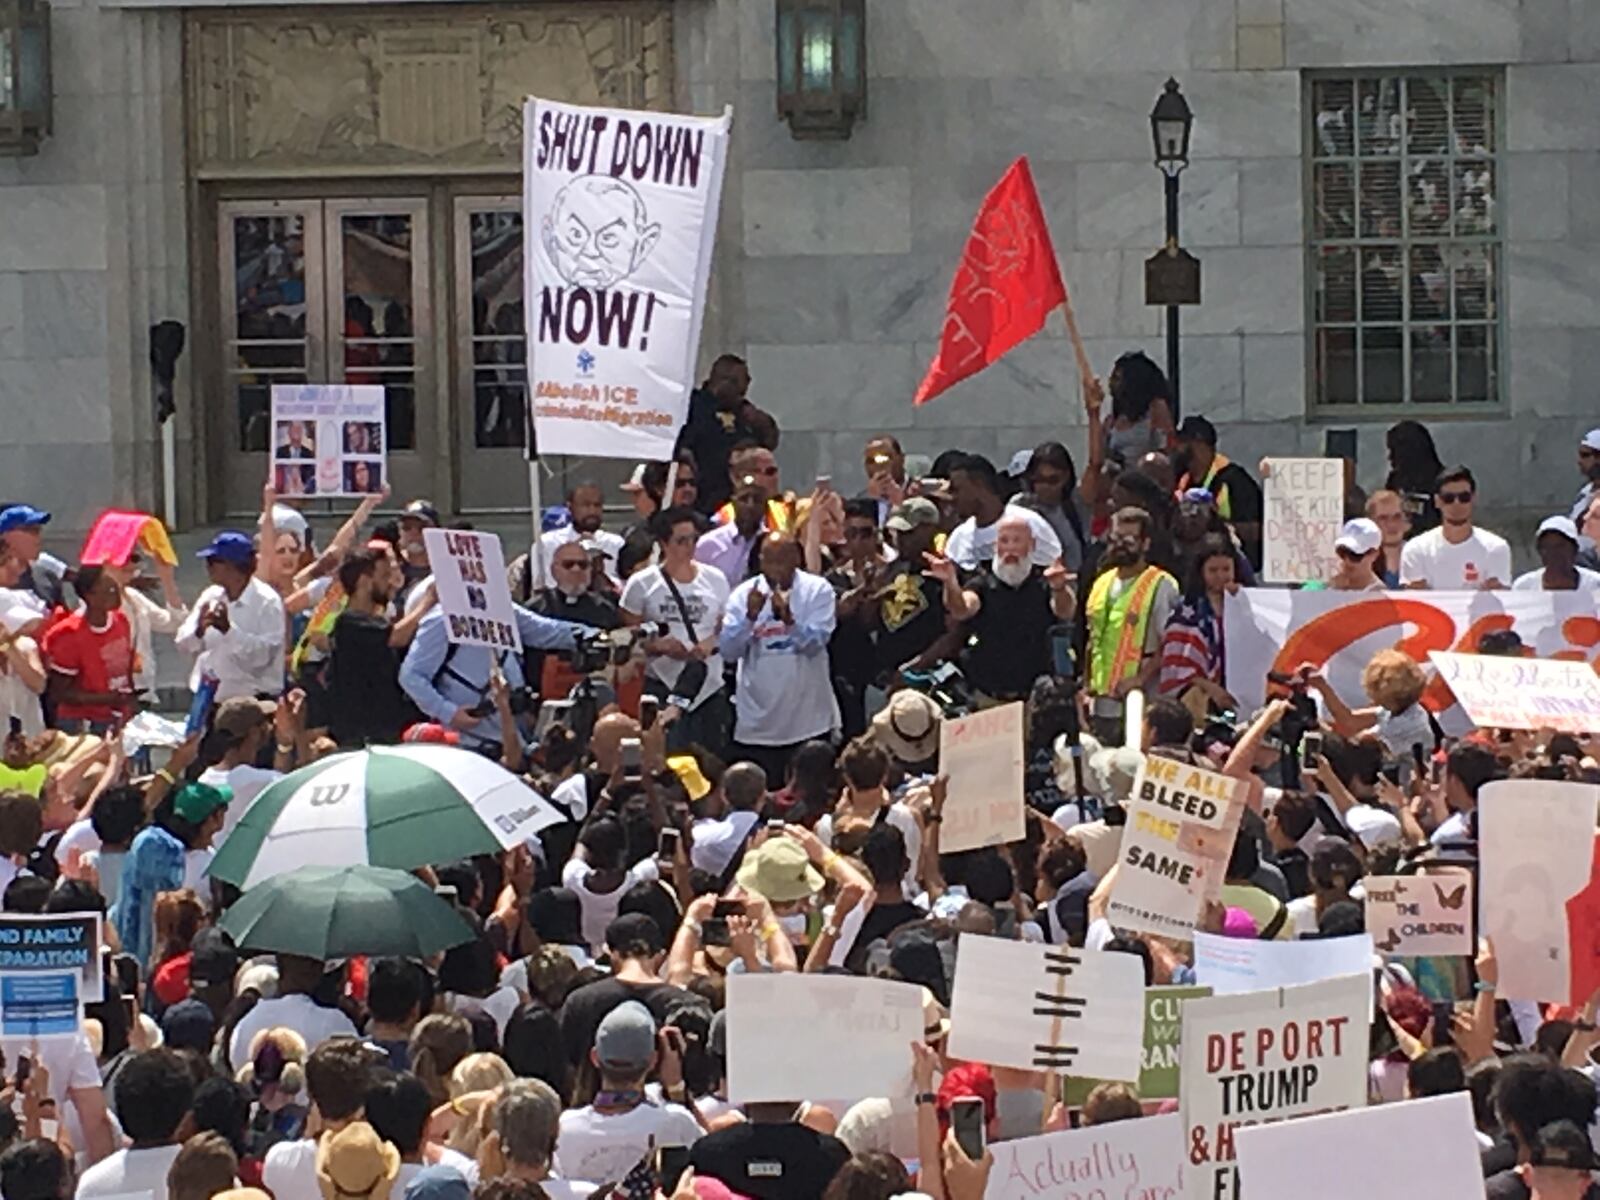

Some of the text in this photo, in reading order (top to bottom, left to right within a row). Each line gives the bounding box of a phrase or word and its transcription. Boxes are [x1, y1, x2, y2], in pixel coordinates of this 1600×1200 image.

[537, 110, 704, 187] SHUT DOWN
[539, 285, 656, 351] NOW!
[603, 385, 640, 405] ICE
[1272, 462, 1338, 490] KEEP
[1270, 496, 1304, 518] THE
[1268, 519, 1338, 542] DEPORT
[444, 532, 483, 558] LOVE
[458, 559, 487, 584] HAS
[467, 585, 487, 611] NO
[449, 614, 516, 648] BORDERS
[1145, 758, 1229, 800] WE ALL
[1140, 780, 1218, 821] BLEED
[1135, 810, 1180, 842] THE
[1126, 845, 1194, 886] SAME
[1368, 890, 1396, 902] FREE
[1396, 903, 1420, 915] THE
[23, 926, 84, 944] FAMILY
[1401, 922, 1464, 936] CHILDREN
[1218, 1064, 1319, 1116] TRUMP
[1190, 1124, 1211, 1166] &
[1008, 1141, 1140, 1196] Actually
